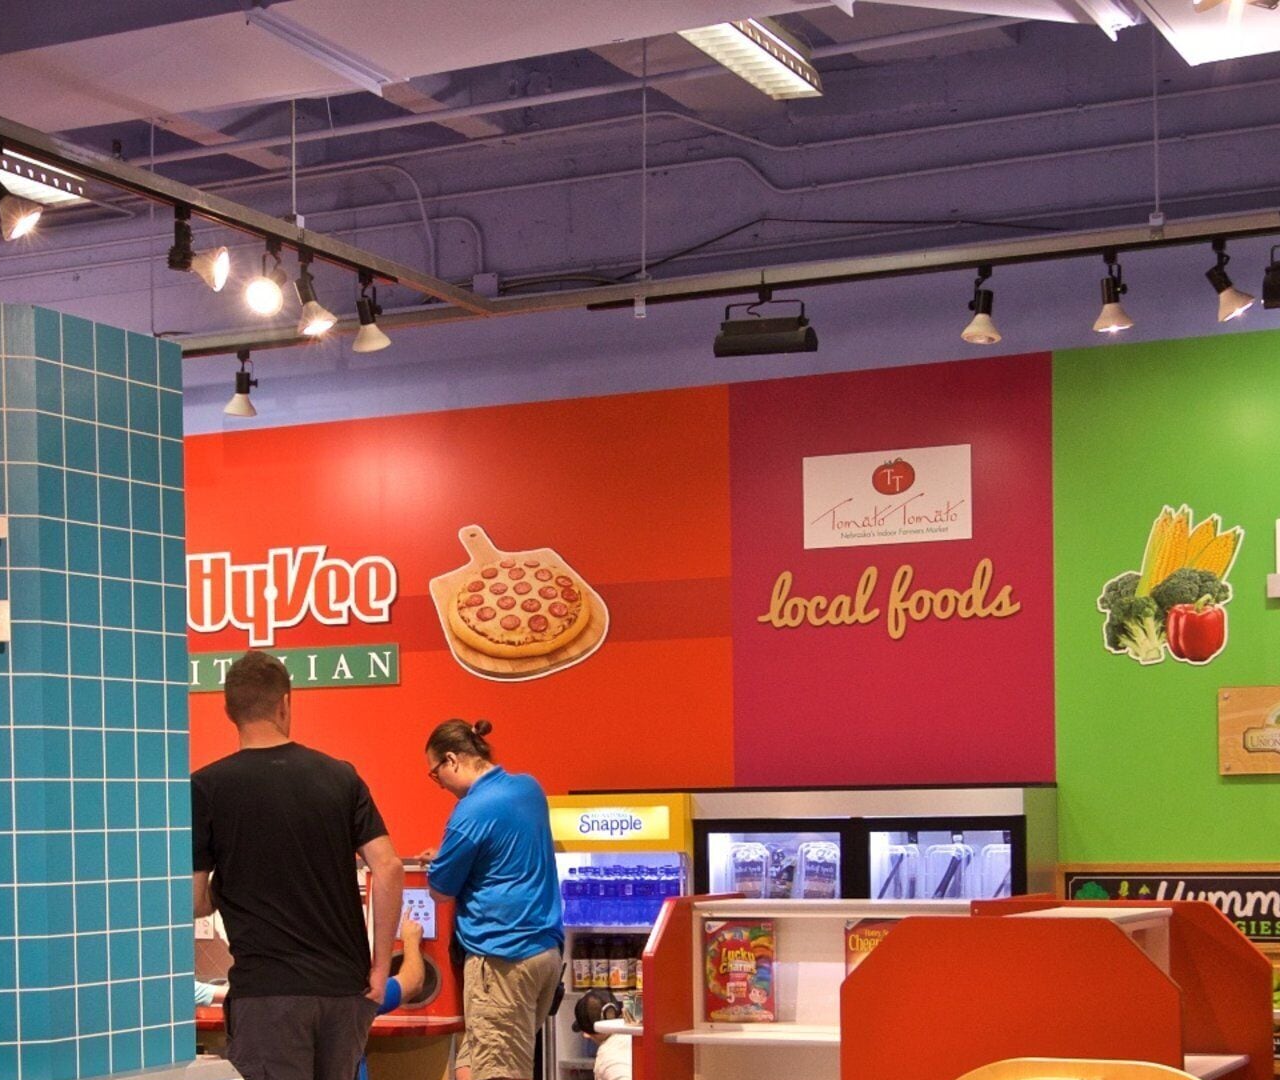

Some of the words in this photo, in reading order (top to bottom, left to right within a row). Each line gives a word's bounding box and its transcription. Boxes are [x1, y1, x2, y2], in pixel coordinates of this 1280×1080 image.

[757, 566, 880, 628] local
[888, 558, 1020, 640] foods
[190, 652, 392, 686] ITIAN
[579, 814, 642, 836] Snapple
[721, 947, 756, 962] Lucky
[719, 960, 757, 974] Charms
